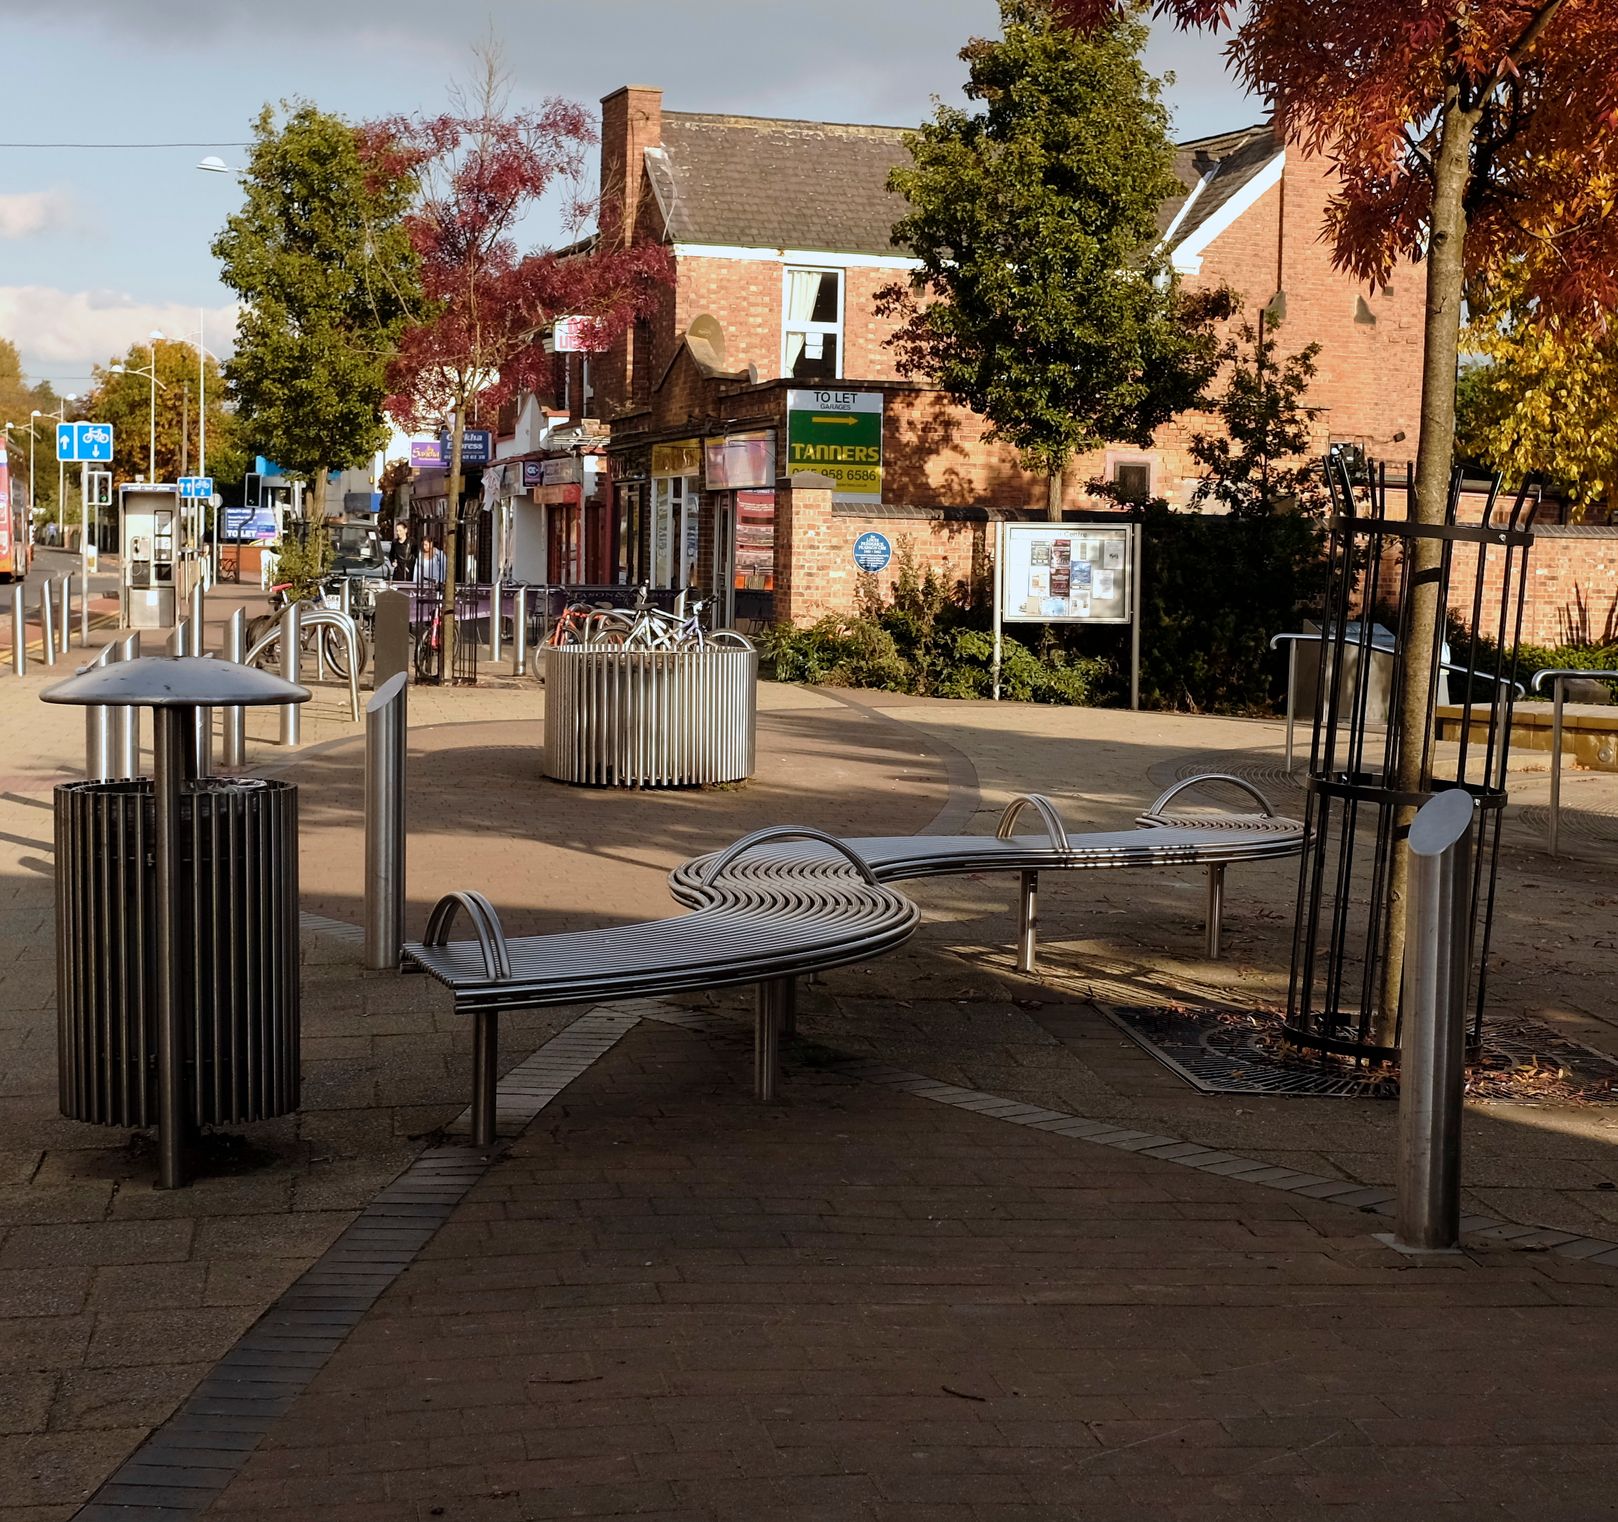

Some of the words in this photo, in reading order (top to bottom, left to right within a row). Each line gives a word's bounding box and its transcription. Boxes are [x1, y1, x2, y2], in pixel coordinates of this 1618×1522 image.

[813, 391, 831, 403] TO
[835, 392, 858, 404] LET
[446, 433, 483, 442] Gkha
[446, 442, 484, 450] Eress
[790, 443, 880, 462] TANNERS
[821, 469, 843, 480] 958
[847, 470, 877, 481] 6586
[227, 530, 238, 538] TO
[241, 530, 257, 538] LET
